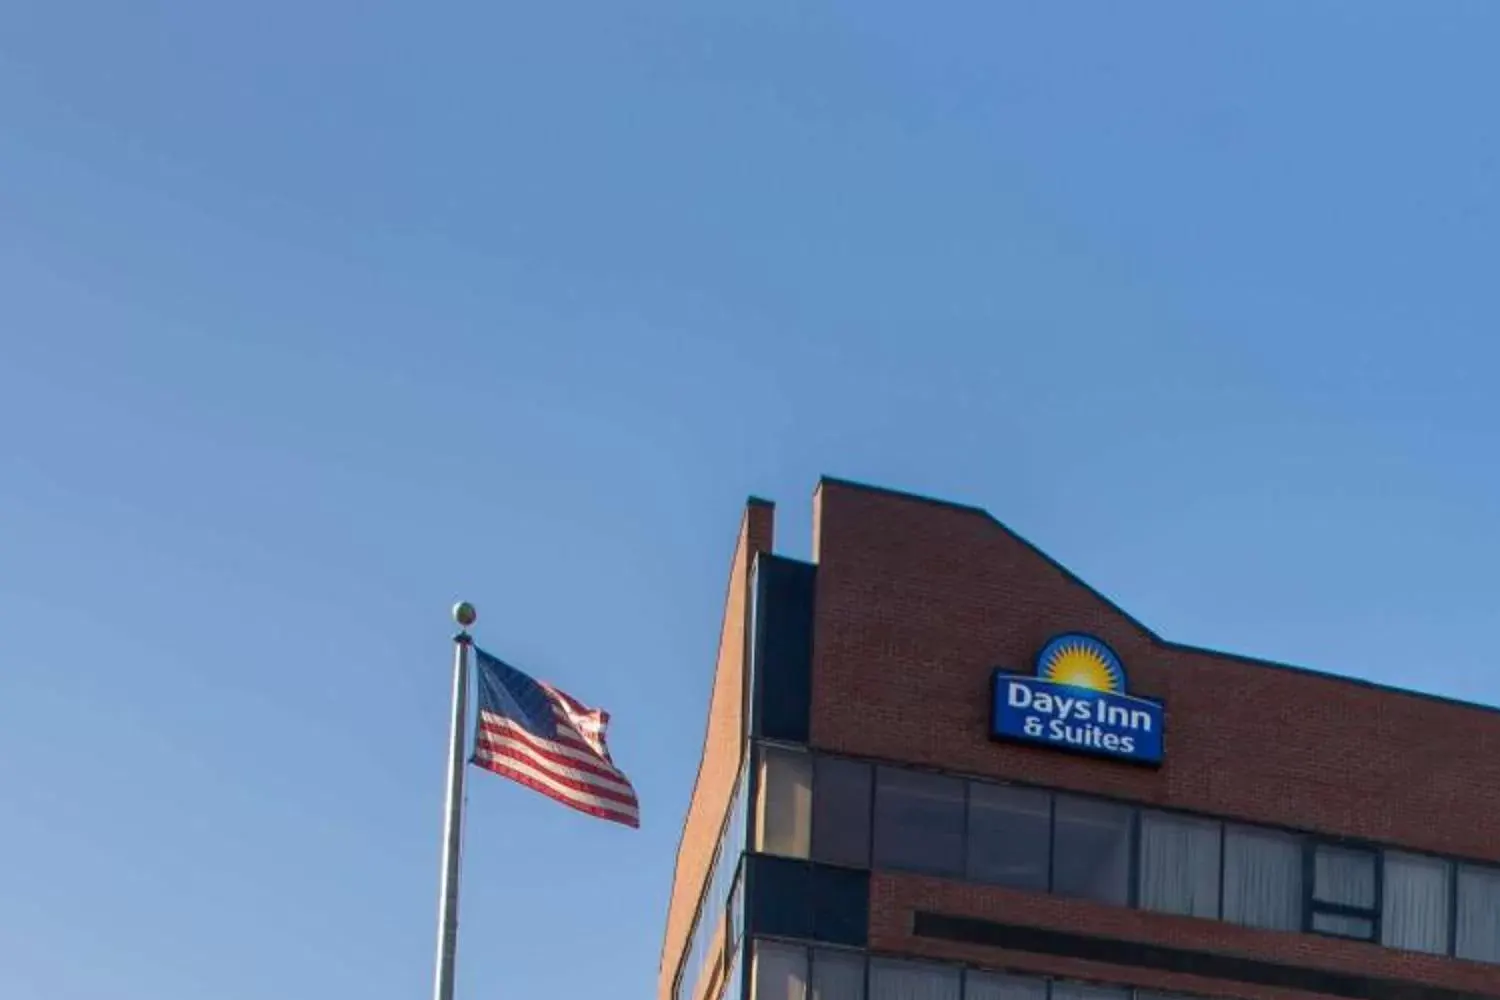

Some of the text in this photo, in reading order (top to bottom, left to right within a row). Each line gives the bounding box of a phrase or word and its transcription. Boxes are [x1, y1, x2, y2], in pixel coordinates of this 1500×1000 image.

[1008, 682, 1152, 732] Days Inn
[1024, 716, 1135, 753] & Suites
